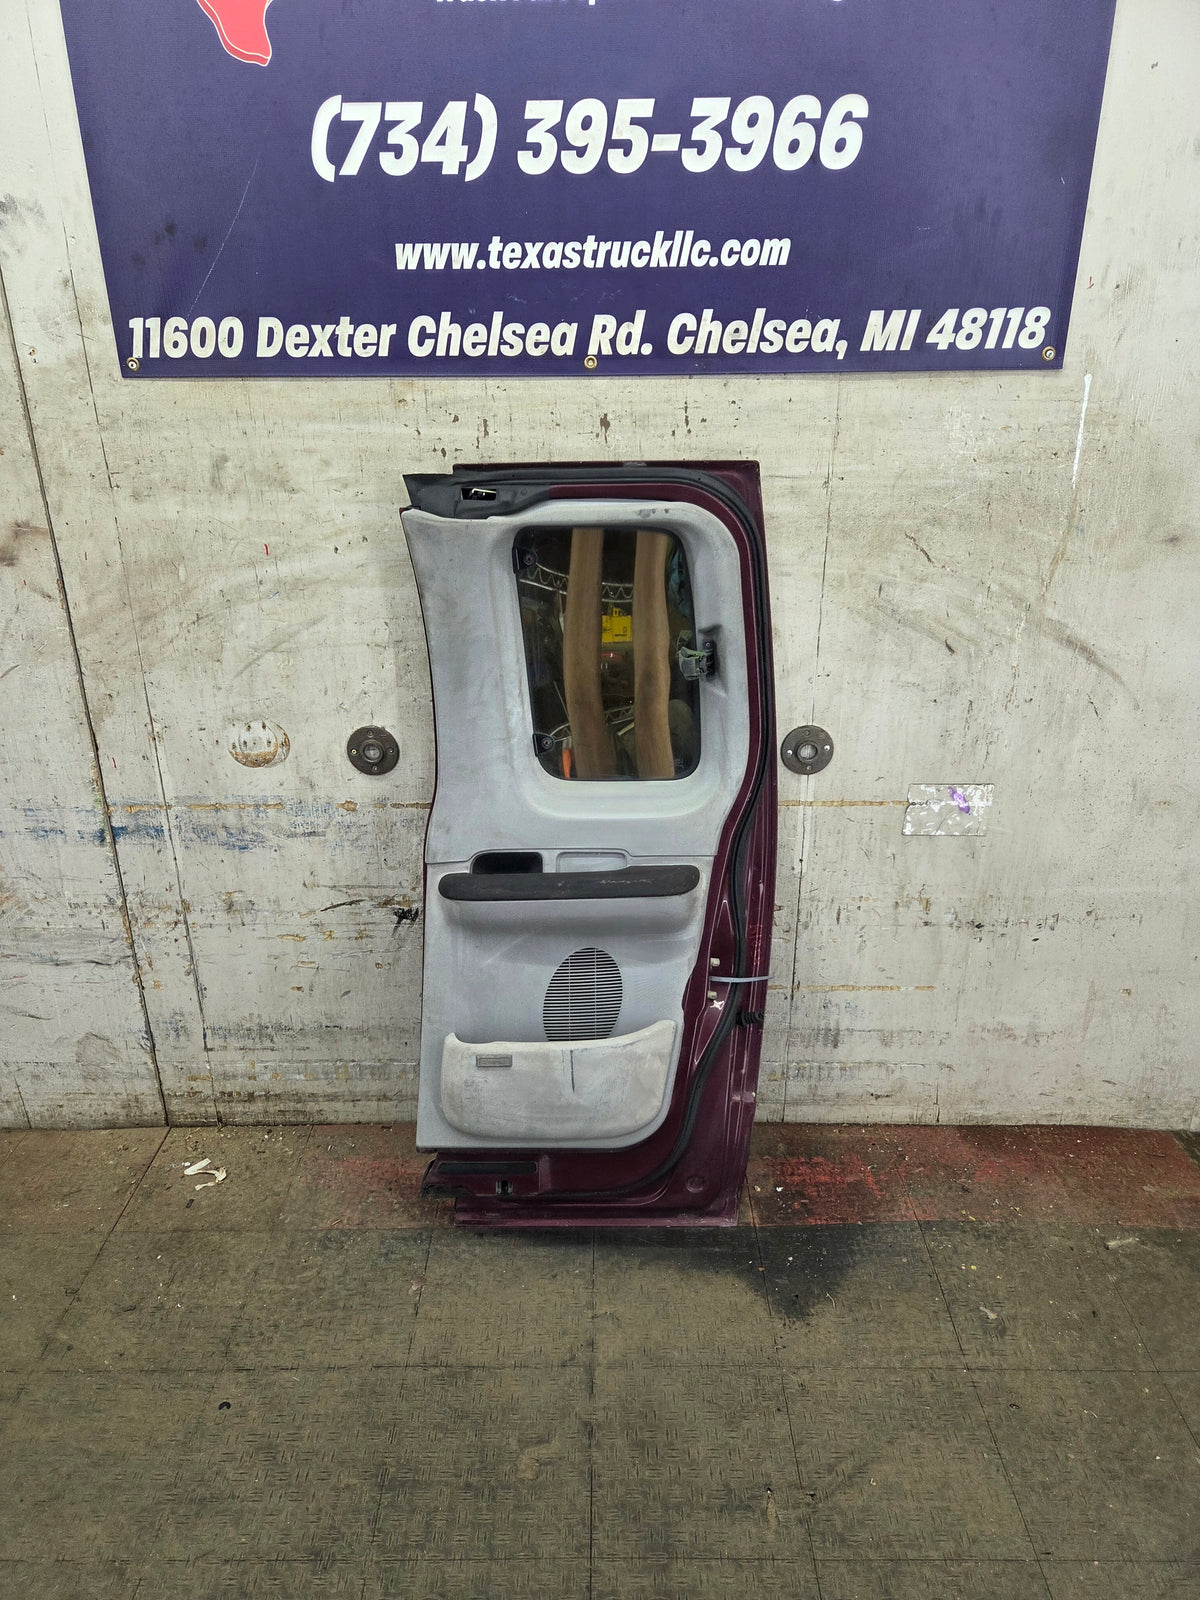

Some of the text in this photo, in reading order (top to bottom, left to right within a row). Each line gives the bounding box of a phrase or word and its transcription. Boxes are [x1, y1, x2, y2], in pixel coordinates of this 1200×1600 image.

[310, 93, 869, 183] (734) 395-3966
[394, 230, 791, 270] www.texastruckllc.com
[128, 306, 1052, 360] 11600 Dexter Chelsea Rd. Chelsea, MI 48118
